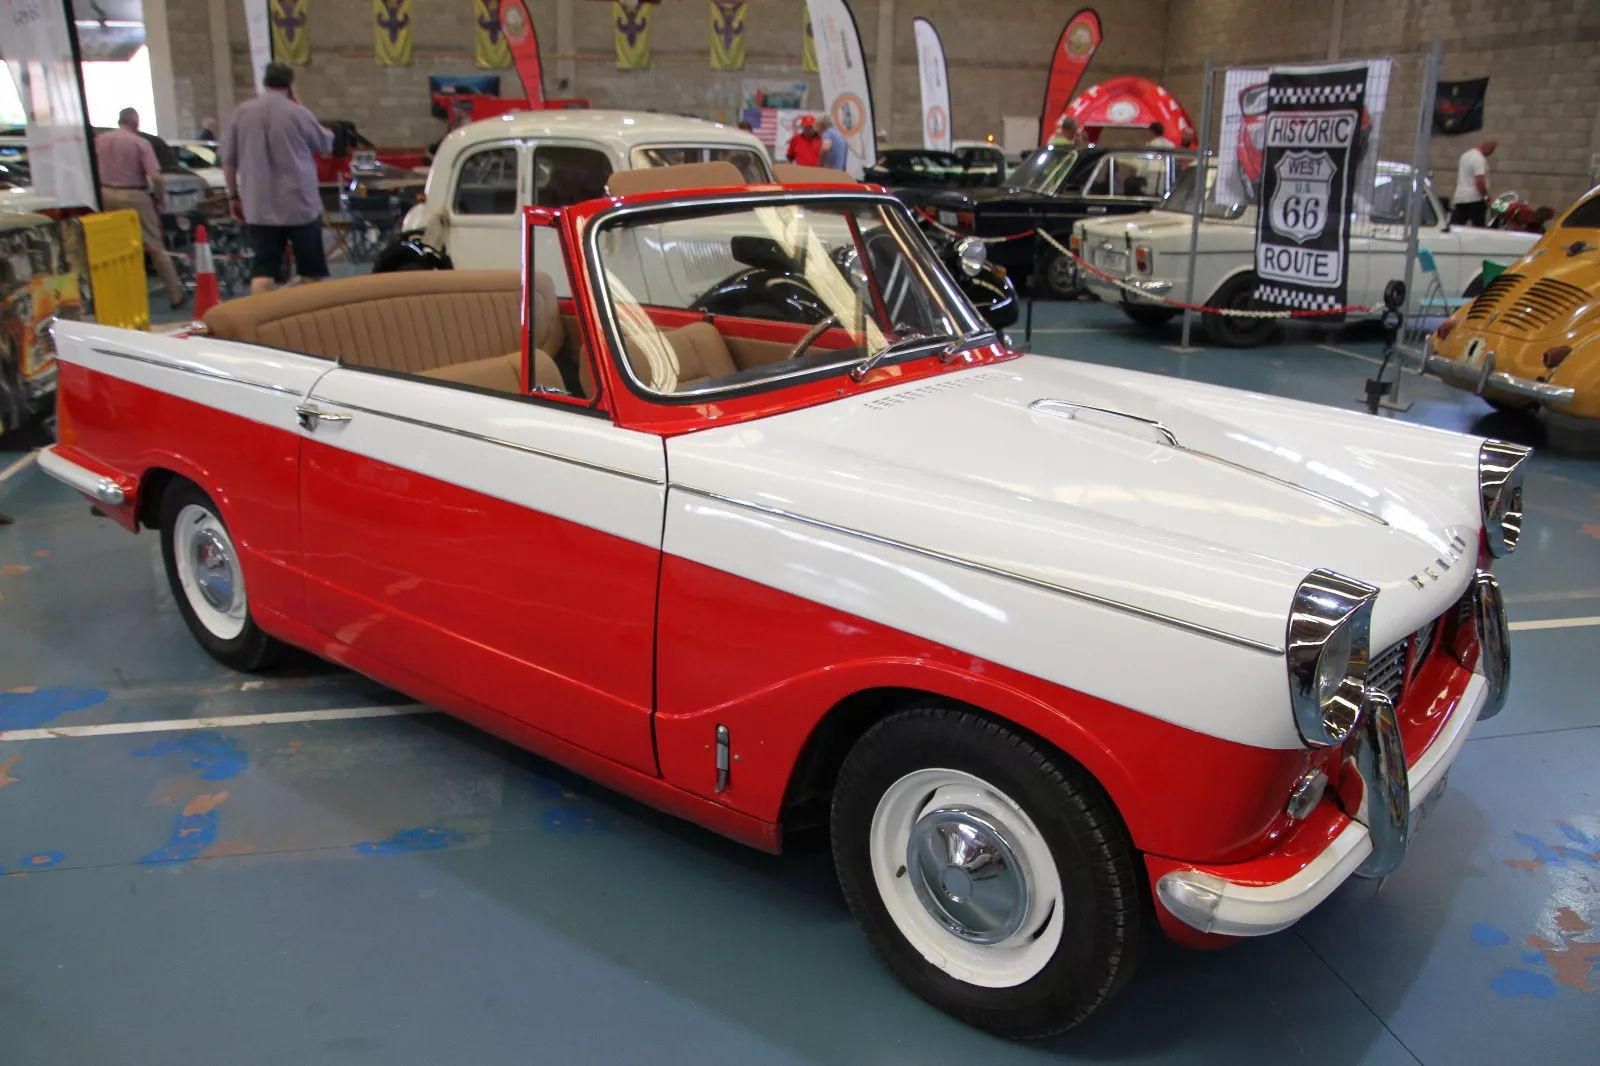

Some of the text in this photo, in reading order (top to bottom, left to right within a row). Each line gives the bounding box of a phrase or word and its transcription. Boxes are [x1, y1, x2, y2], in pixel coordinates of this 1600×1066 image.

[1272, 118, 1349, 143] HISTORIC
[1289, 160, 1322, 176] WEST
[1283, 196, 1319, 229] 66
[1264, 247, 1329, 276] ROUTE
